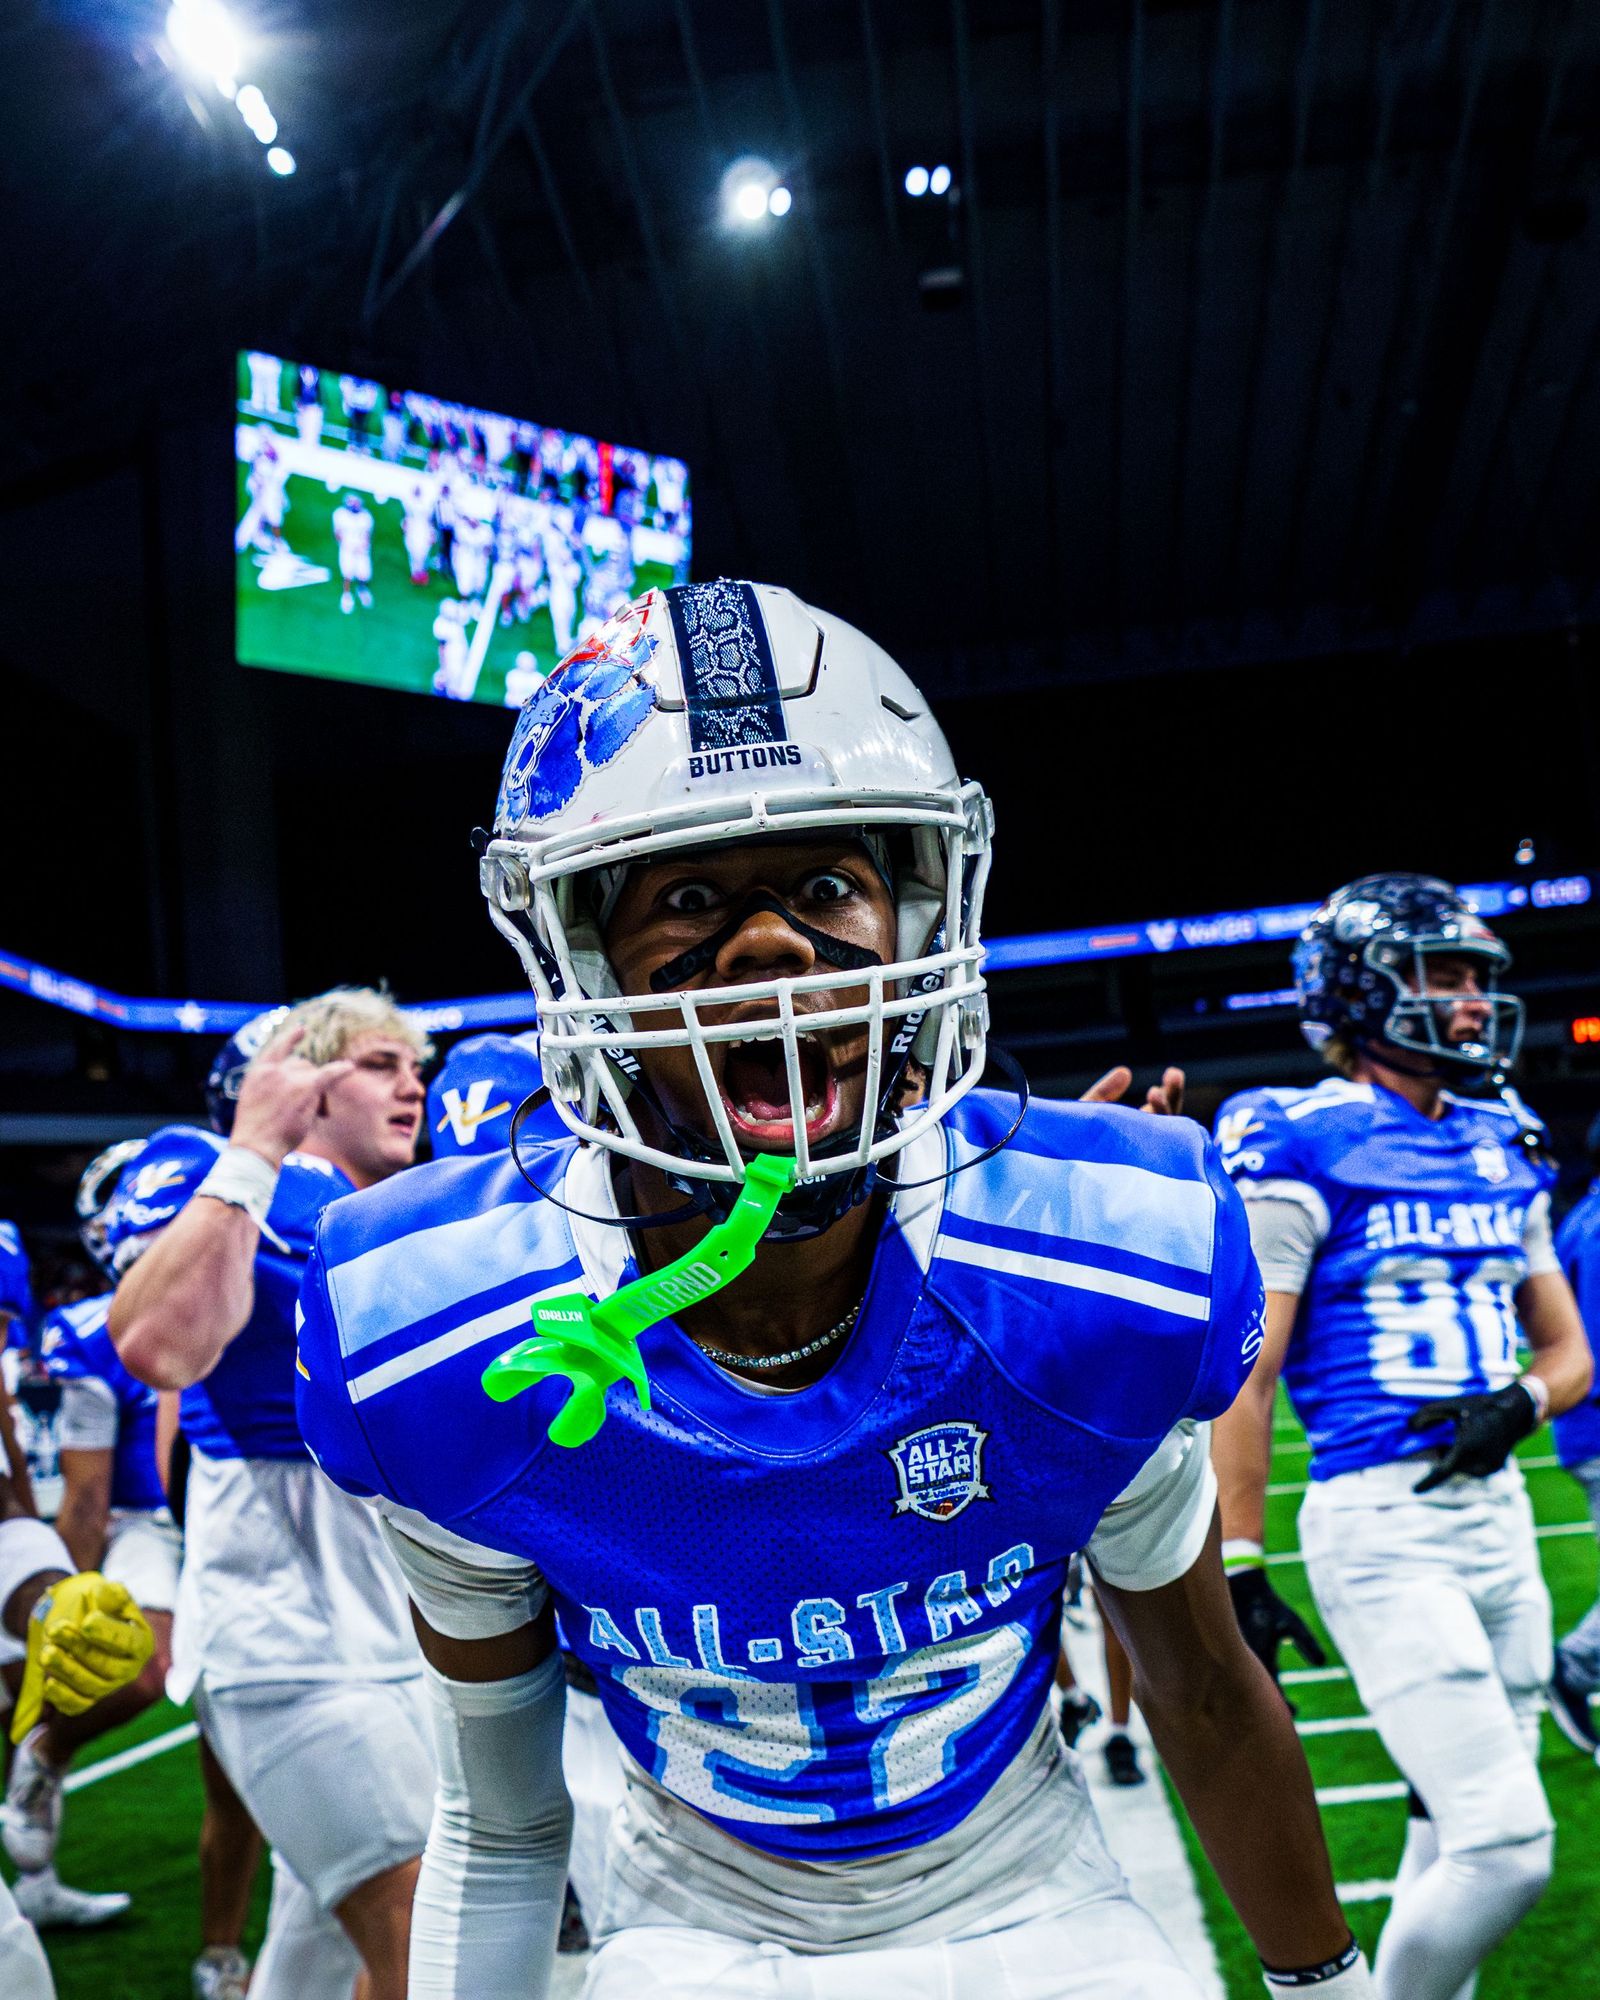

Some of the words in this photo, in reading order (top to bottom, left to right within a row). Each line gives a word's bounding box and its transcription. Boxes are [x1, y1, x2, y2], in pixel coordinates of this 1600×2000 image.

[688, 744, 802, 778] BUTTONS
[622, 1261, 722, 1324] NXTRND
[537, 1309, 585, 1323] NXTRND
[908, 1439, 952, 1466] ALL
[908, 1454, 971, 1484] STAR
